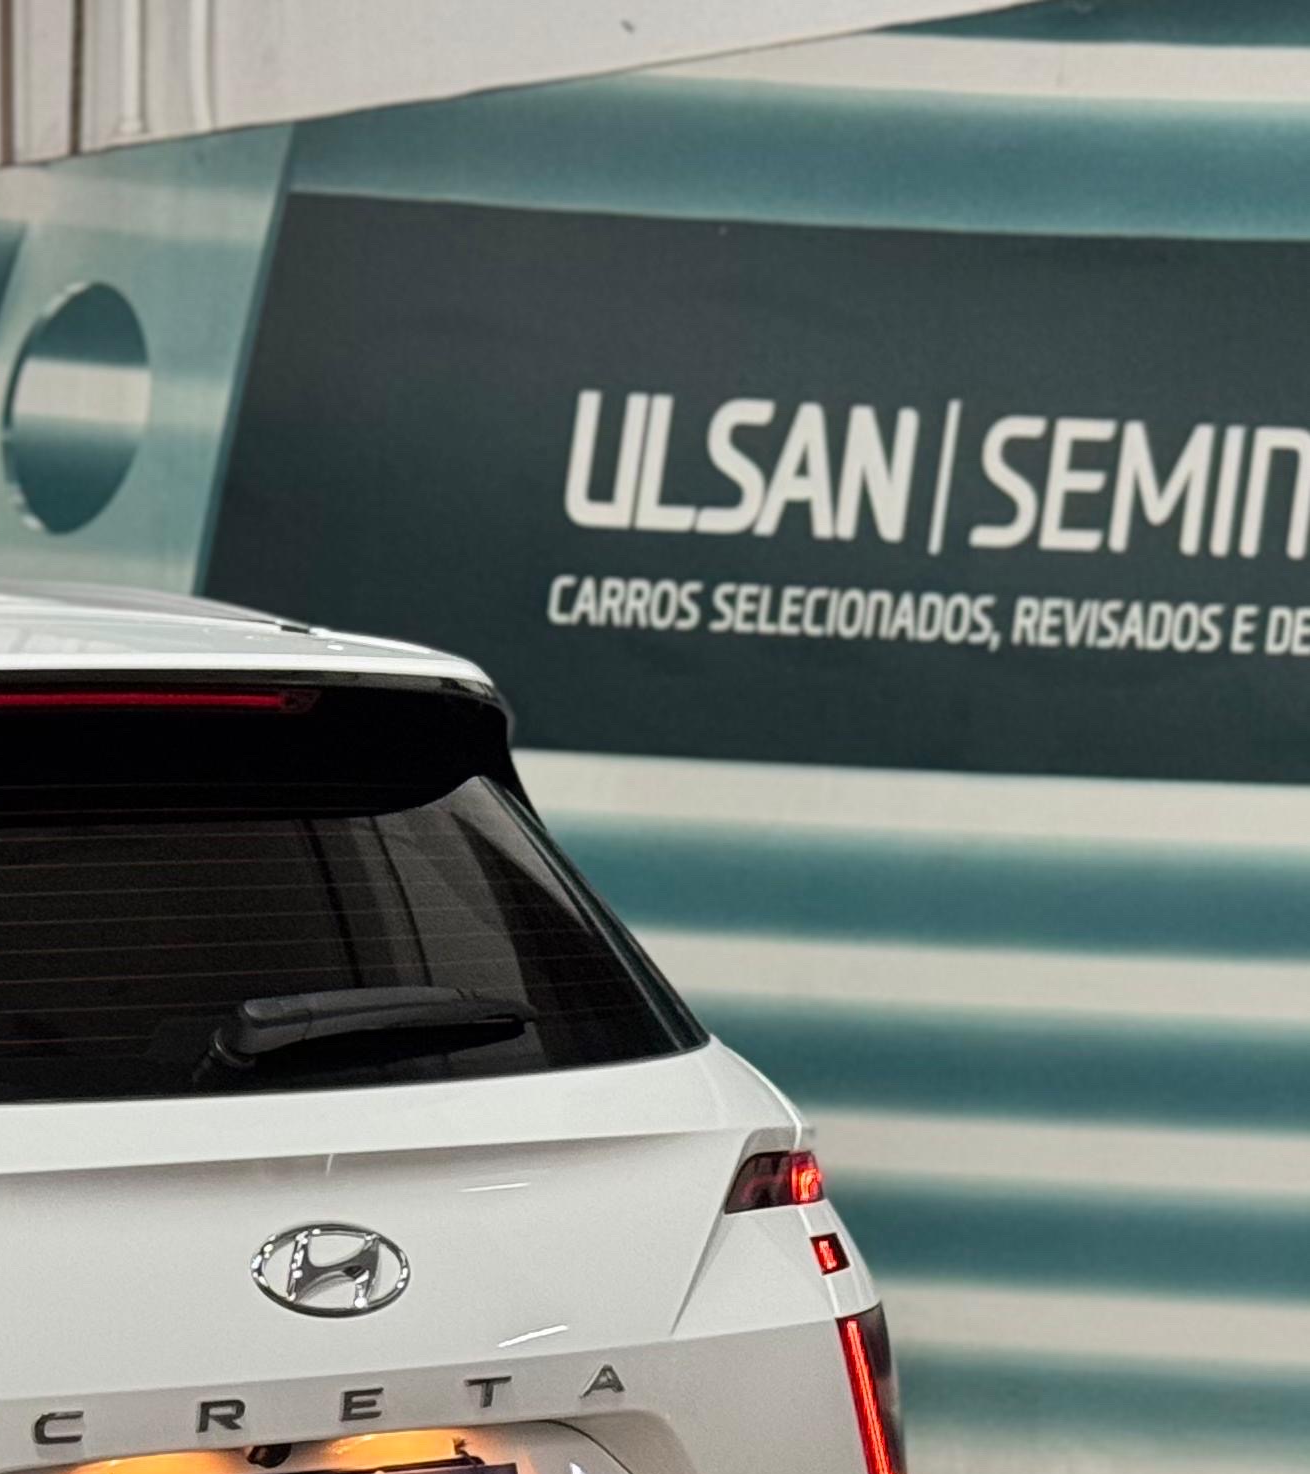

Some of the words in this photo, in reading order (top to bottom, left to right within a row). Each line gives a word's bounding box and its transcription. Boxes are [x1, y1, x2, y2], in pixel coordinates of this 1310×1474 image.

[565, 391, 920, 542] ULSAN
[968, 414, 1310, 561] SEMIN
[547, 575, 701, 630] CARROS
[709, 582, 1000, 651] SELECIONADOS,
[1012, 597, 1225, 653] REVISADOS
[1230, 603, 1261, 655] E
[34, 1363, 626, 1445] CRETA
